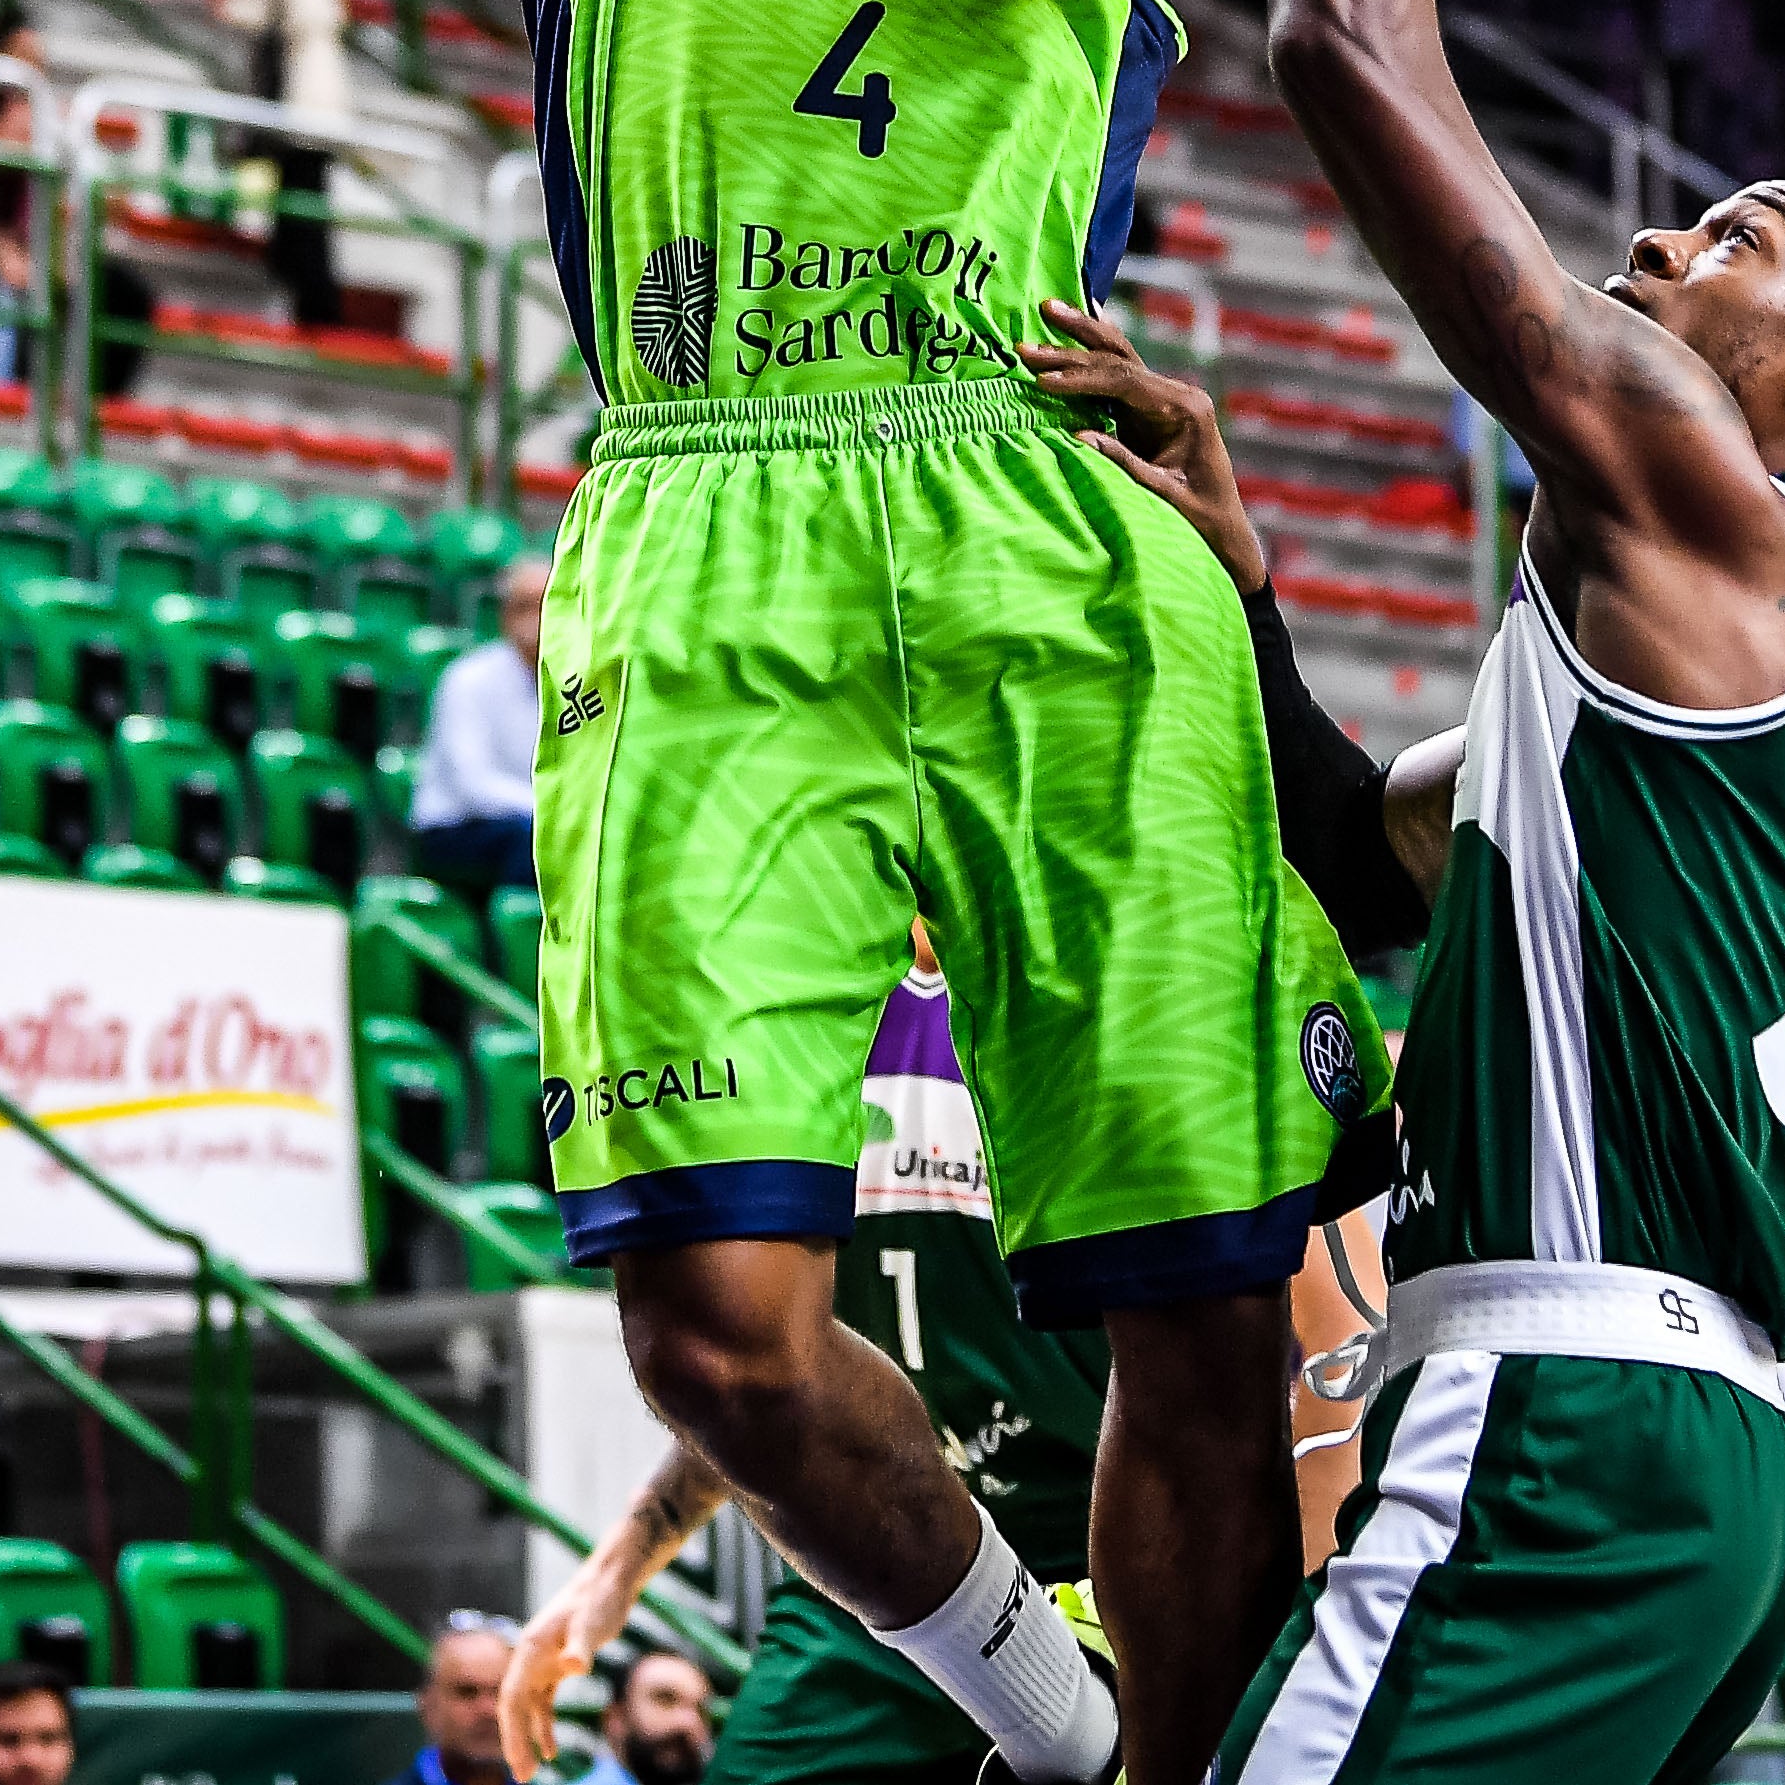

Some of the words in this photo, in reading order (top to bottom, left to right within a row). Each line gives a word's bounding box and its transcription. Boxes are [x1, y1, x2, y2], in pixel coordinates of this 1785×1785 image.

[791, 0, 897, 161] 4
[736, 222, 954, 291] Banco
[583, 1057, 740, 1127] TISCALI
[879, 1246, 926, 1373] 1
